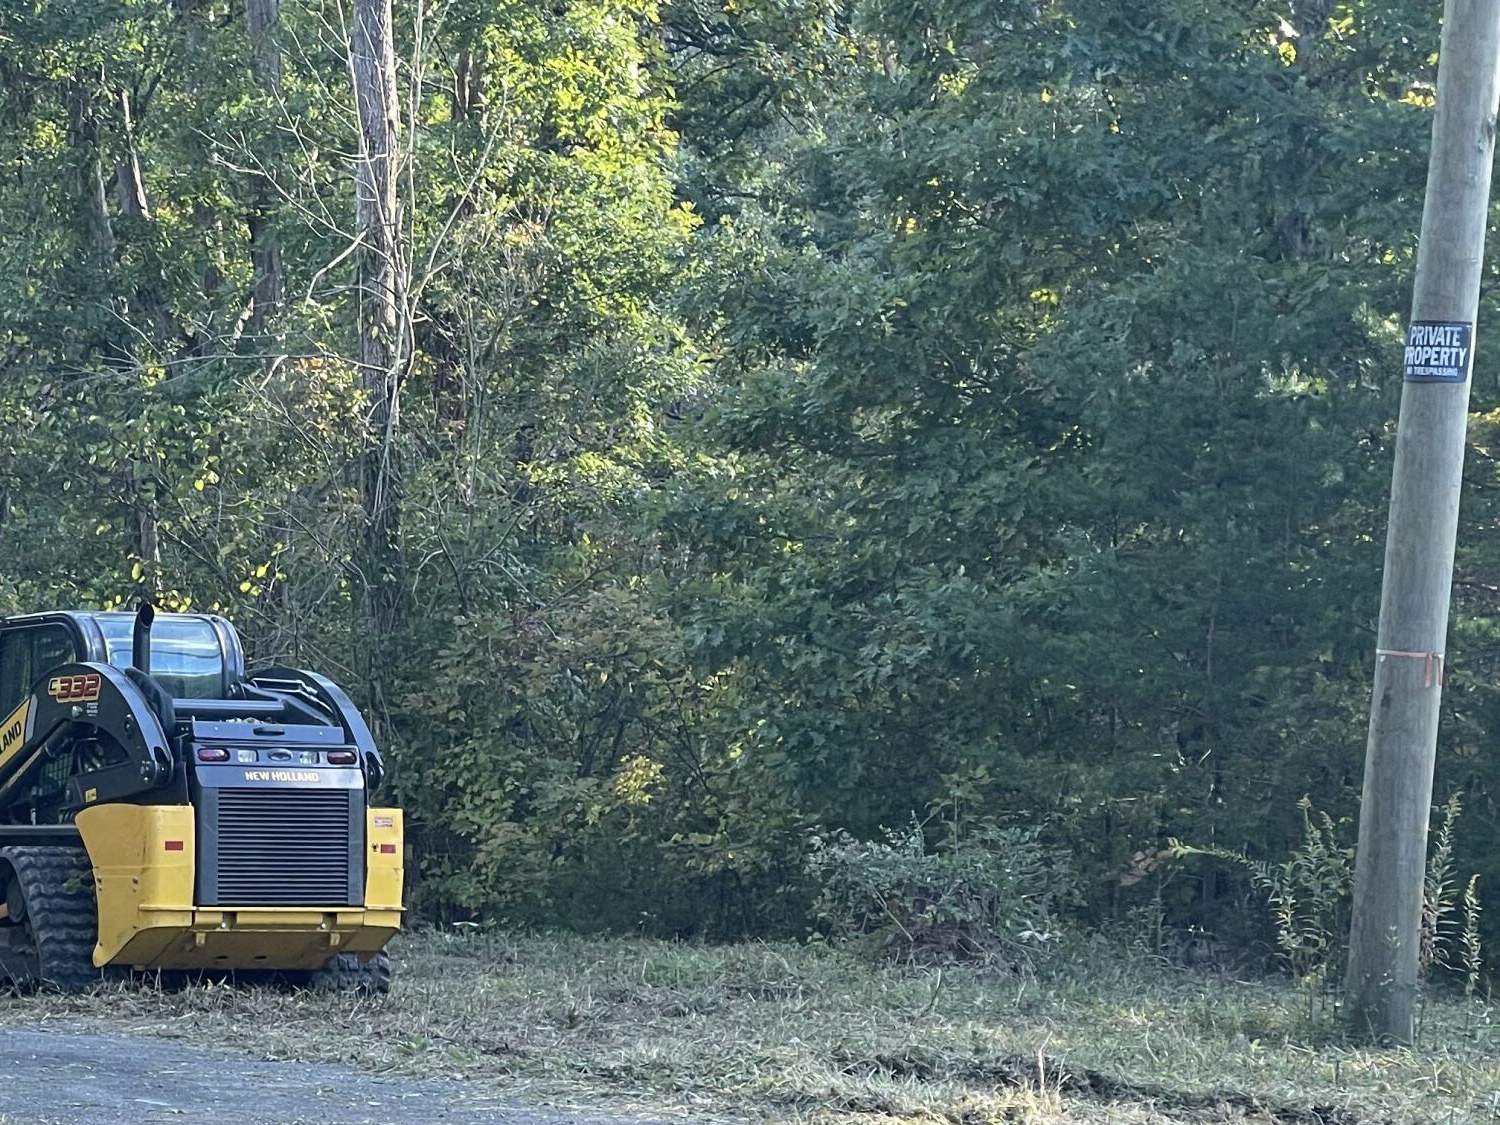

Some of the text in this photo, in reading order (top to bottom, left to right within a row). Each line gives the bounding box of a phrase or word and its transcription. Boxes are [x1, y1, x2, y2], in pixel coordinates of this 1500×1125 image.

[1410, 326, 1462, 346] PRIVATE
[1404, 346, 1467, 366] PROPERTY
[245, 771, 320, 782] NEW HOLLAND
